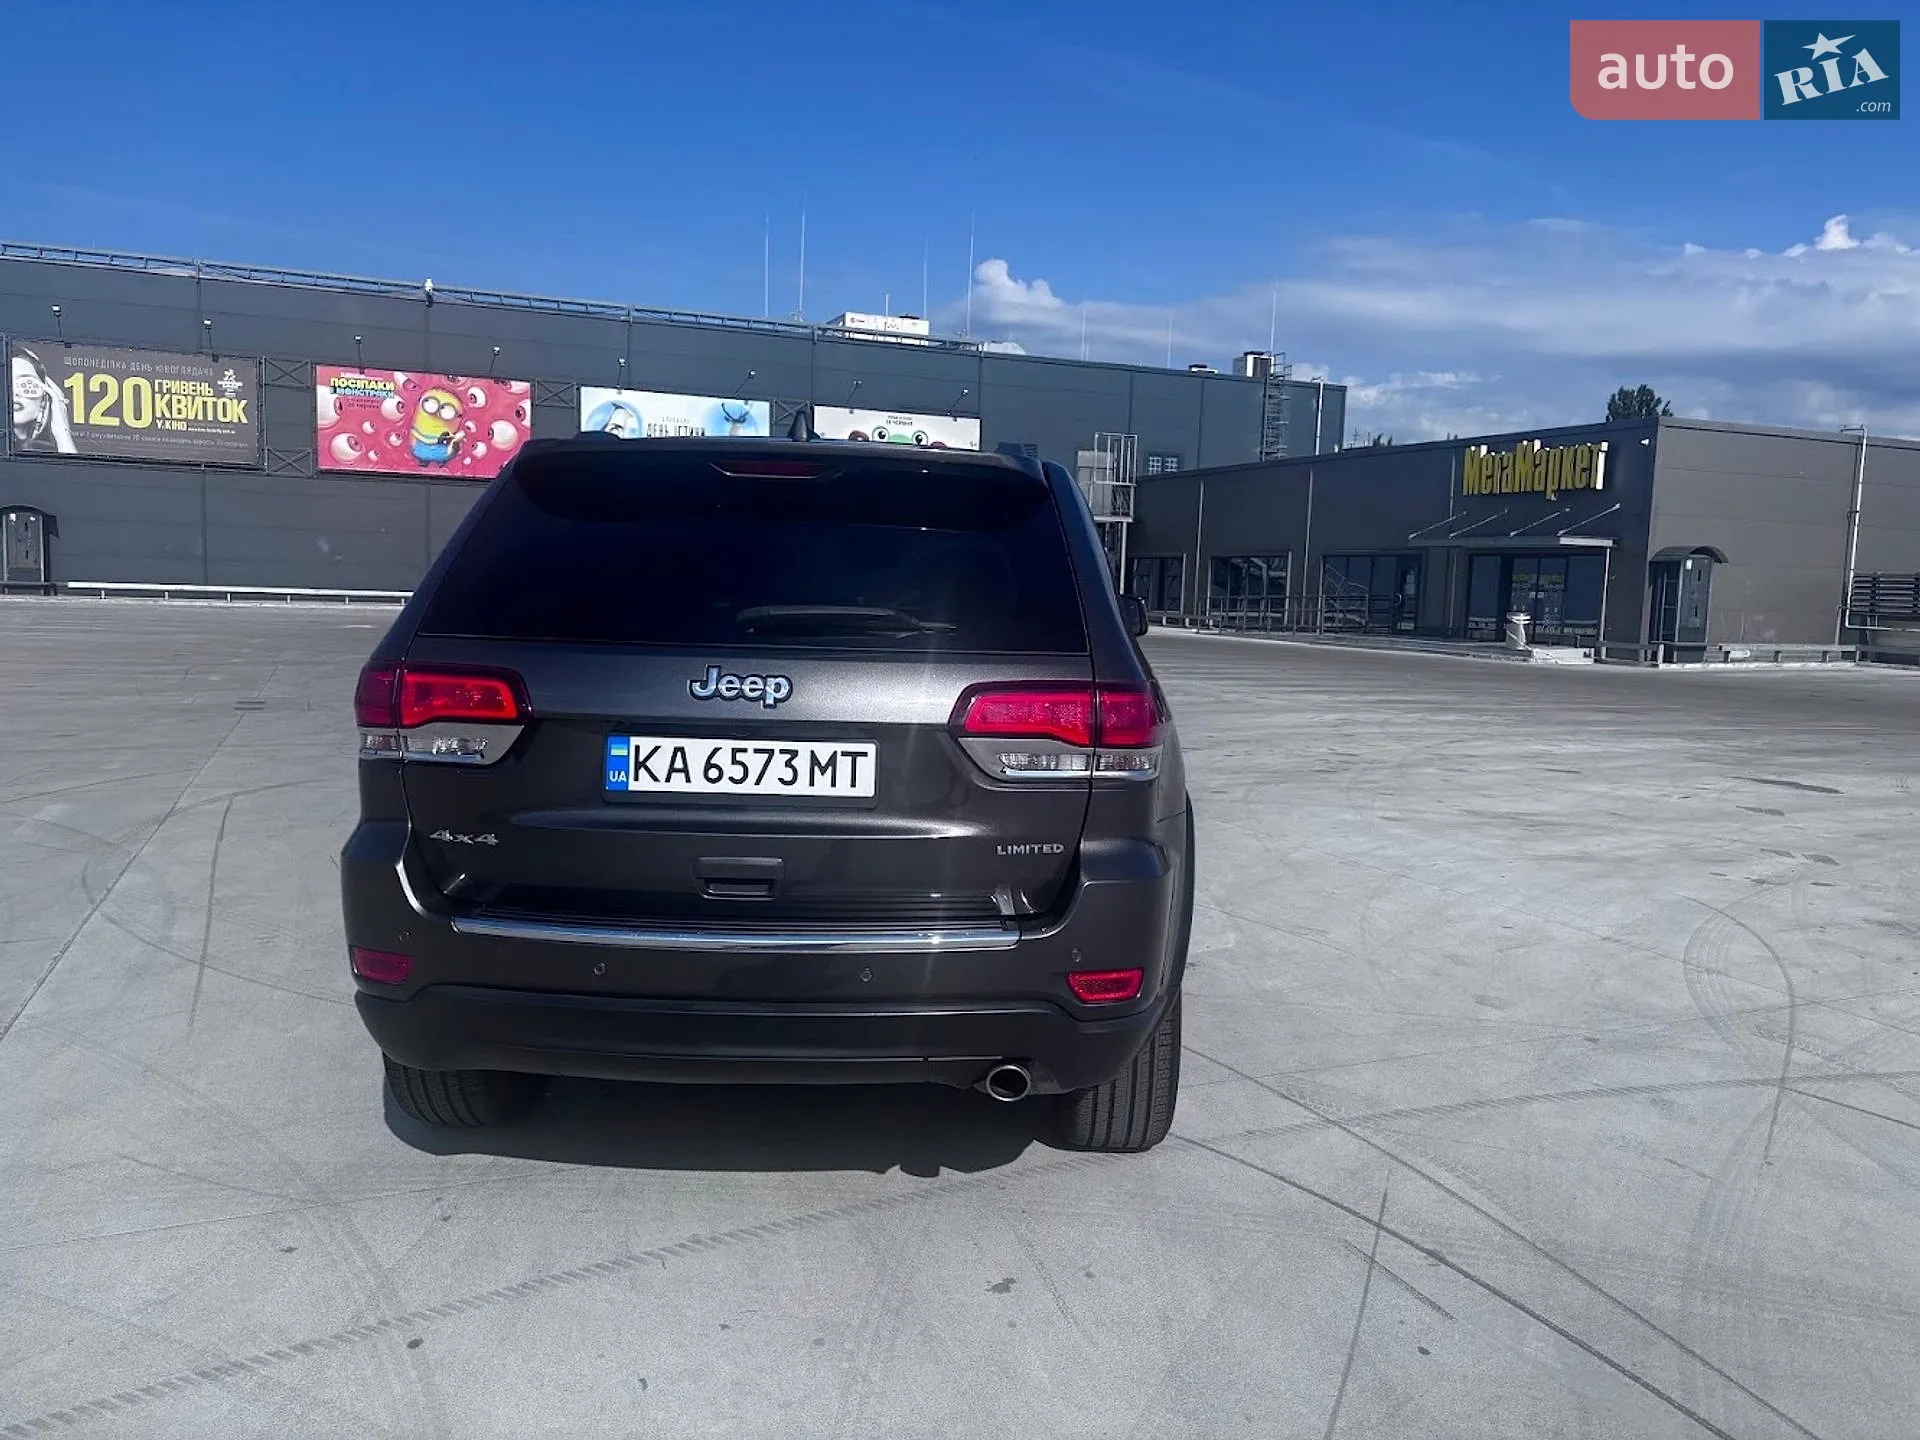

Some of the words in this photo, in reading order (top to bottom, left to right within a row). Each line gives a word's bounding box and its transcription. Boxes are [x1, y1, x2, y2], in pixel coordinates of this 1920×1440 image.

[63, 372, 153, 429] 120
[154, 379, 214, 397] ГРИВЕНЬ
[154, 393, 249, 424] КВИТОК
[1463, 439, 1608, 501] МегаМаркет
[688, 664, 793, 708] Jeep
[609, 771, 627, 782] UA
[633, 744, 691, 783] KA
[703, 747, 799, 786] 6573
[809, 750, 868, 788] MT
[429, 829, 498, 846] 4x4
[996, 843, 1065, 856] LIMITED
